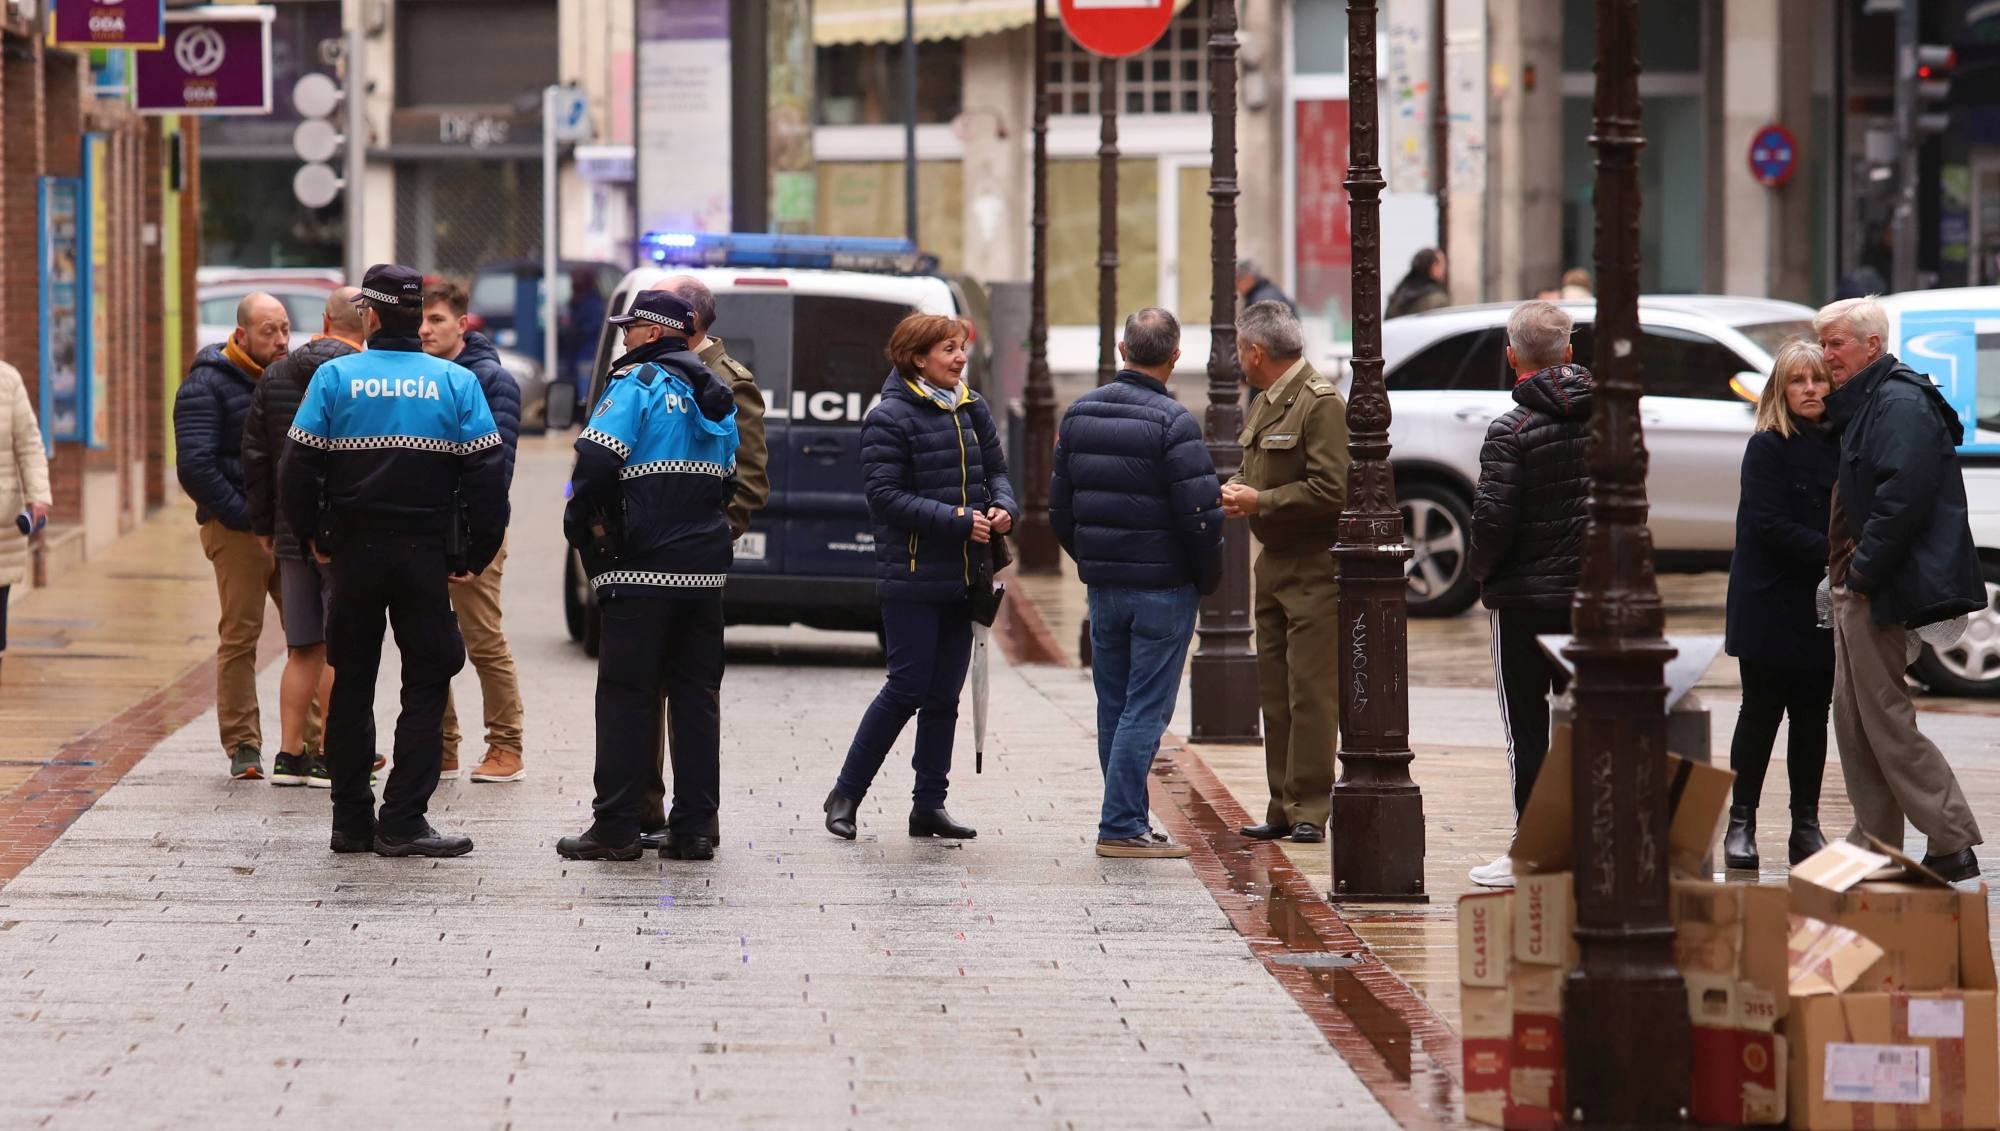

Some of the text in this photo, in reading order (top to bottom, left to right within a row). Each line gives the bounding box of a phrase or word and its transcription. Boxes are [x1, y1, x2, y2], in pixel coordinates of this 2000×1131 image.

[351, 375, 440, 401] POLICÍA
[760, 389, 882, 421] LICI
[1472, 906, 1487, 979] CLASSIC
[1528, 883, 1543, 956] CLASSIC
